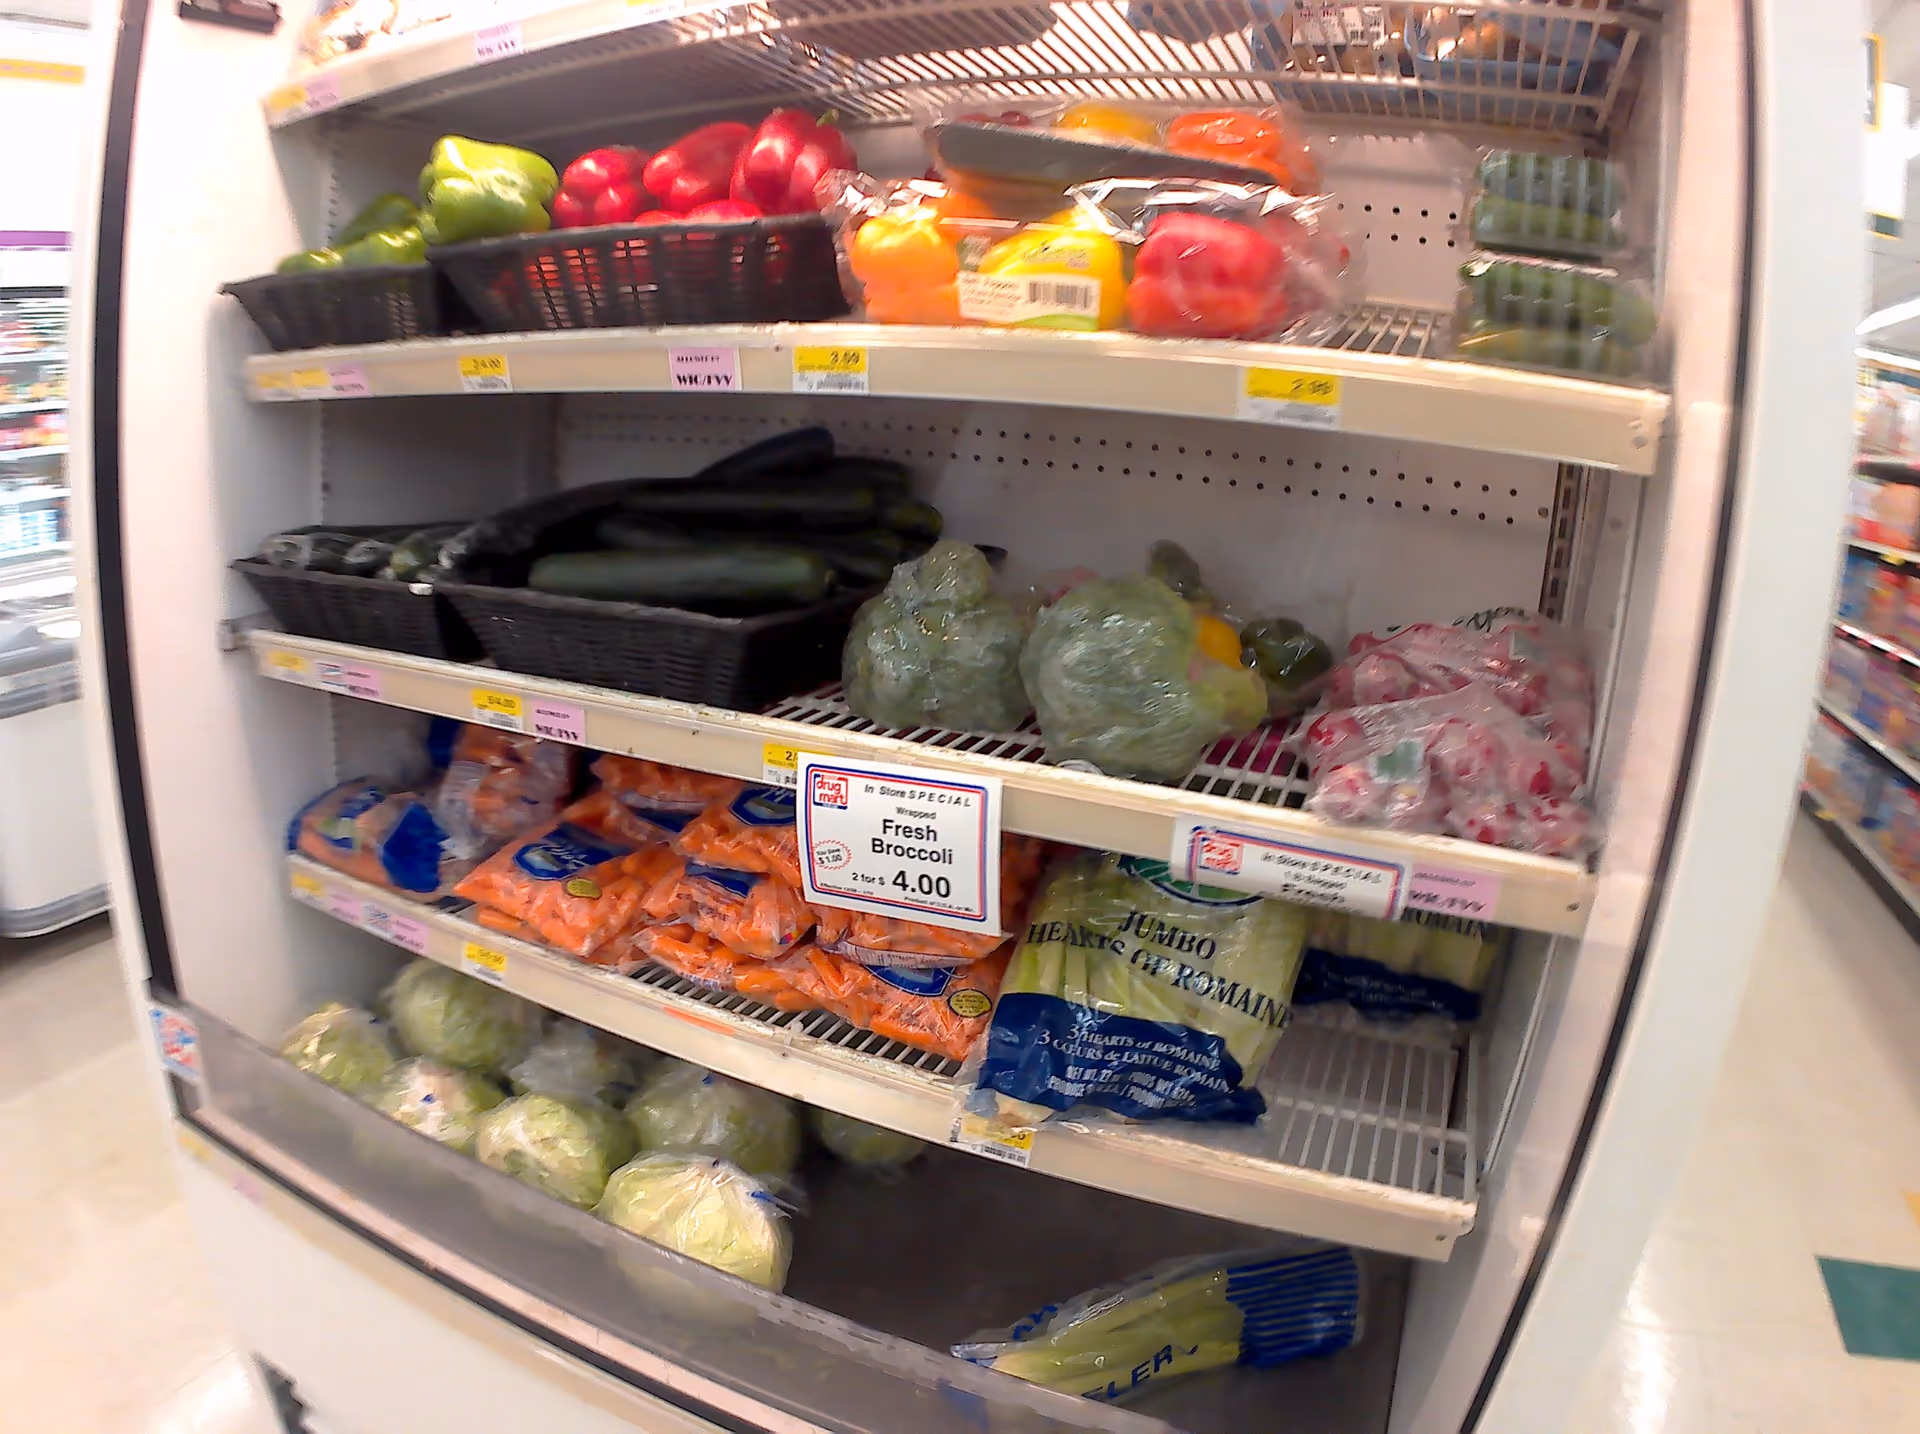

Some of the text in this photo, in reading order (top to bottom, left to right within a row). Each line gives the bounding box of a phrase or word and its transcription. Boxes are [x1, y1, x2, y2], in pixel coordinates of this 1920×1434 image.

[879, 786, 907, 798] Store
[909, 791, 972, 807] SPECIAL
[882, 819, 938, 842] Fresh
[871, 837, 953, 865] Broccoli
[892, 871, 951, 899] 4.00
[1027, 921, 1125, 955] HEARTS
[1117, 911, 1217, 960] JUMBO
[1082, 1032, 1135, 1048] HEARTS
[1152, 1042, 1222, 1071] ROMAINE
